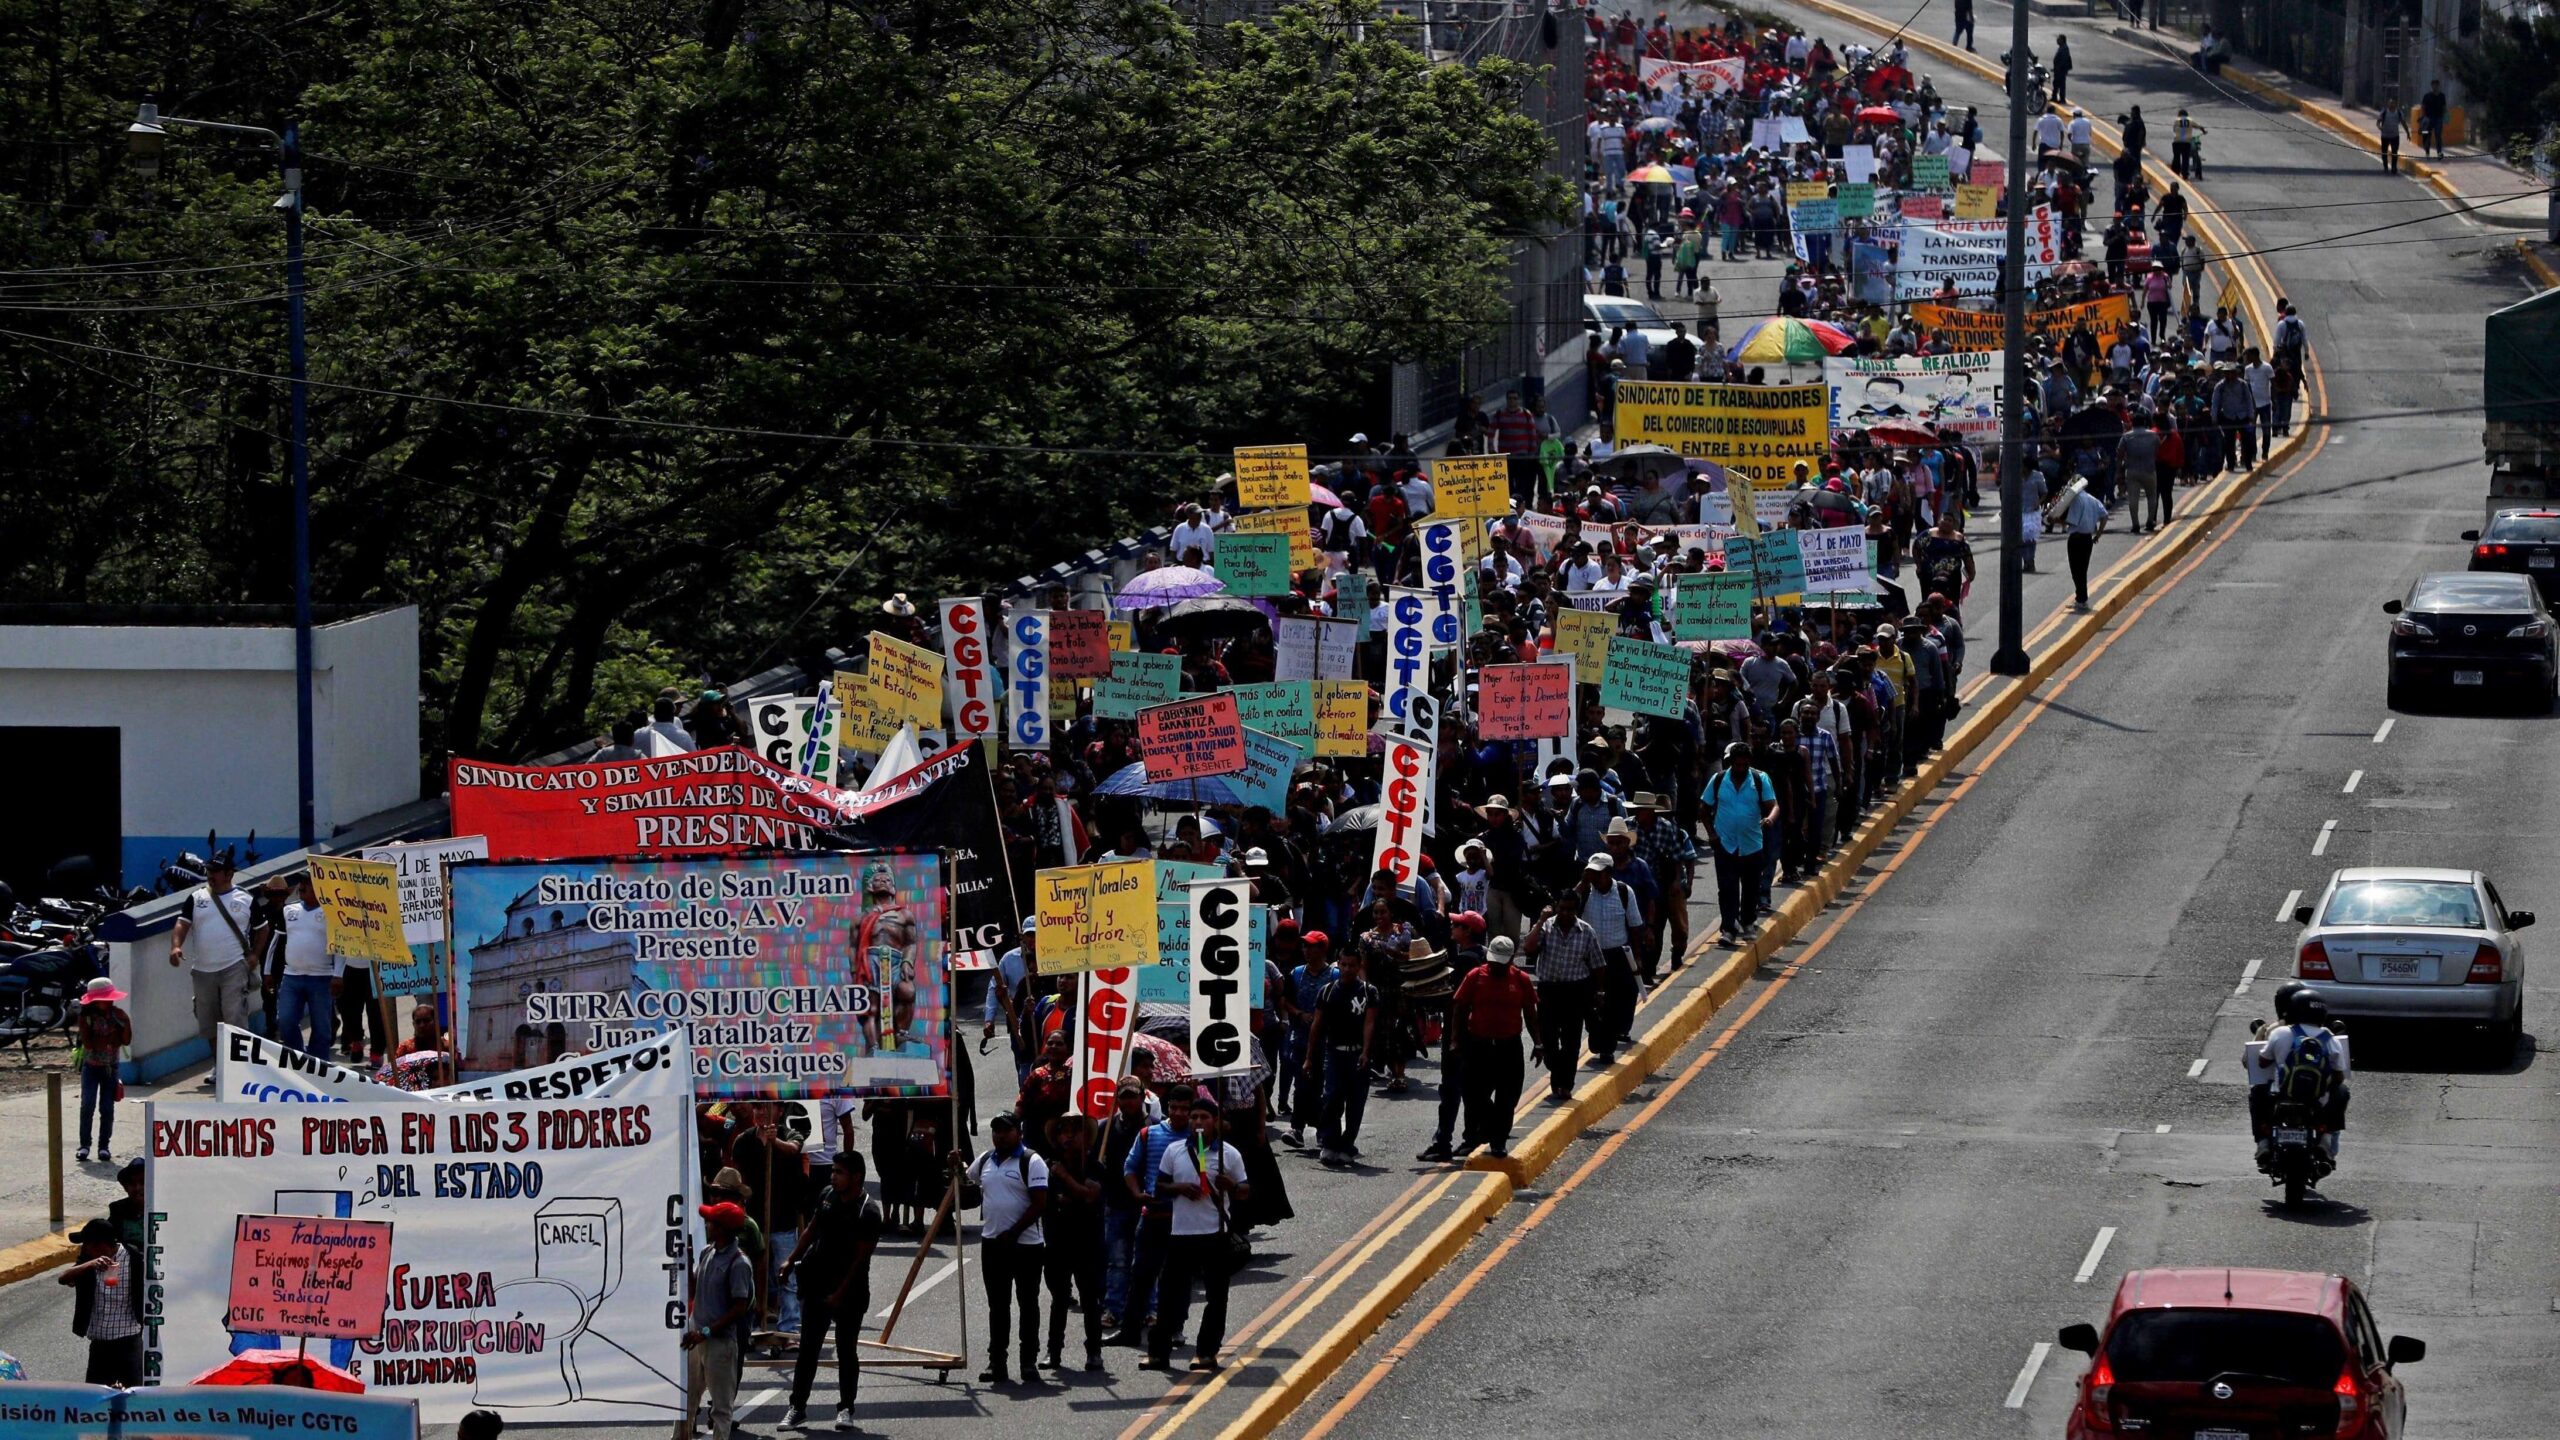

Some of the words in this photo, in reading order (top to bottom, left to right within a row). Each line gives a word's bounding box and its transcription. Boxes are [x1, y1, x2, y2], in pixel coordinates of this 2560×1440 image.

[1925, 237, 1942, 249] LA
[2036, 207, 2054, 263] CGTG
[1912, 272, 1922, 281] Y
[1924, 270, 1997, 283] DIGNIDAD
[1854, 357, 1898, 372] TRISTE
[1921, 352, 1990, 371] REALIDAD
[1618, 385, 1680, 405] SINDICATO
[1685, 387, 1704, 406] DE
[1709, 388, 1822, 409] TRABAJADORES
[1643, 414, 1663, 433] DEL
[1667, 416, 1724, 434] COMERCIO
[1727, 418, 1741, 434] DE
[1742, 417, 1806, 437] ESQUIPULAS
[1986, 419, 1997, 431] DE
[1682, 440, 1730, 457] ENTRE
[1738, 442, 1747, 458] 8
[1750, 442, 1760, 456] Y
[1764, 442, 1772, 457] 9
[1776, 442, 1824, 459] CALLE
[1239, 463, 1249, 474] los
[1493, 458, 1502, 468] los
[1767, 465, 1786, 481] DE
[1244, 485, 1254, 494] del
[1457, 493, 1481, 504] CICIG
[1695, 528, 1707, 539] de
[1816, 533, 1822, 550] 1
[1826, 537, 1836, 550] DE
[1839, 534, 1862, 549] MAYO
[1425, 524, 1458, 643] CGTG
[1717, 575, 1746, 597] gobierno
[1560, 615, 1582, 632] Carcel
[1582, 625, 1588, 639] y
[1687, 613, 1713, 625] cambio
[1573, 639, 1579, 647] a
[1626, 644, 1639, 656] viva
[1641, 641, 1648, 656] la
[870, 657, 880, 667] en
[883, 655, 895, 672] las
[949, 603, 990, 734] CGTG
[869, 671, 880, 686] del
[1015, 616, 1044, 745] CGTG
[1609, 671, 1619, 686] de
[1624, 672, 1633, 688] la
[1639, 677, 1669, 695] Persona
[1097, 687, 1106, 698] al
[1111, 688, 1141, 701] cambio
[1237, 688, 1259, 701] más
[1265, 686, 1286, 699] odio
[1294, 690, 1300, 704] y
[1314, 682, 1323, 699] al
[1326, 682, 1362, 706] gobierno
[1494, 691, 1516, 709] Exige
[1669, 684, 1683, 715] CGTG
[850, 707, 862, 722] los
[869, 711, 904, 729] Partidos
[1157, 704, 1205, 724] GOBIERNO
[1212, 702, 1227, 714] NO
[1263, 710, 1274, 719] en
[1276, 700, 1303, 717] contra
[1316, 703, 1357, 720] deterioro
[1490, 711, 1525, 722] denuncia
[1534, 708, 1543, 721] el
[1548, 708, 1565, 721] mal
[1158, 715, 1216, 732] GARANTIZA
[1280, 720, 1313, 739] Sindical
[1194, 737, 1237, 752] VIVIENDA
[1148, 768, 1173, 780] CGTG
[1182, 758, 1233, 775] PRESENTE
[1172, 754, 1179, 765] Y
[1185, 751, 1215, 763] OTROS
[457, 763, 600, 793] SINDICATO
[604, 762, 640, 787] DE
[651, 752, 813, 795] VENDEDORES
[579, 797, 599, 815] Y
[605, 787, 745, 814] SIMILARES
[749, 788, 778, 809] DE
[1378, 743, 1420, 884] CGTG
[328, 869, 337, 881] a
[337, 863, 348, 881] la
[398, 852, 410, 877] 1
[415, 858, 432, 874] DE
[539, 874, 673, 904] Sindicato
[680, 875, 712, 901] de
[720, 870, 775, 897] San
[782, 871, 852, 897] Juan
[1091, 866, 1140, 897] Morales
[318, 886, 333, 906] de
[403, 890, 417, 902] UN
[587, 903, 739, 934] Chamelco,
[744, 901, 805, 928] A.V.
[1106, 910, 1114, 926] y
[638, 933, 758, 961] Presente
[1196, 888, 1240, 1068] CGTG
[527, 986, 870, 1022] SITRACOSIJUCHAB
[1350, 994, 1368, 1016] NY
[228, 1033, 269, 1066] EL
[718, 1050, 845, 1083] Casiques
[152, 1117, 277, 1157] EXIGIMOS
[301, 1112, 389, 1156] PURGA
[399, 1112, 436, 1154] EN
[449, 1112, 498, 1154] LOS
[500, 1110, 530, 1152] 3
[537, 1104, 653, 1151] PODERES
[376, 1162, 421, 1198] DEL
[434, 1160, 543, 1199] ESTADO
[243, 1221, 271, 1242] Las
[255, 1249, 310, 1277] Exigimos
[317, 1250, 364, 1275] Respeto
[661, 1193, 687, 1330] CGTG
[249, 1276, 259, 1287] a
[272, 1271, 285, 1289] la
[302, 1270, 353, 1291] libertad
[392, 1263, 496, 1310] FUERA
[273, 1288, 330, 1305] Sindical
[231, 1305, 265, 1322] CGTG
[280, 1306, 330, 1327] Presente
[372, 1355, 478, 1386] IMPUNIDAD
[64, 1406, 166, 1426] Nacional
[173, 1406, 202, 1424] de
[209, 1406, 231, 1424] la
[236, 1406, 296, 1430] Mujer
[301, 1410, 358, 1434] CGTG
